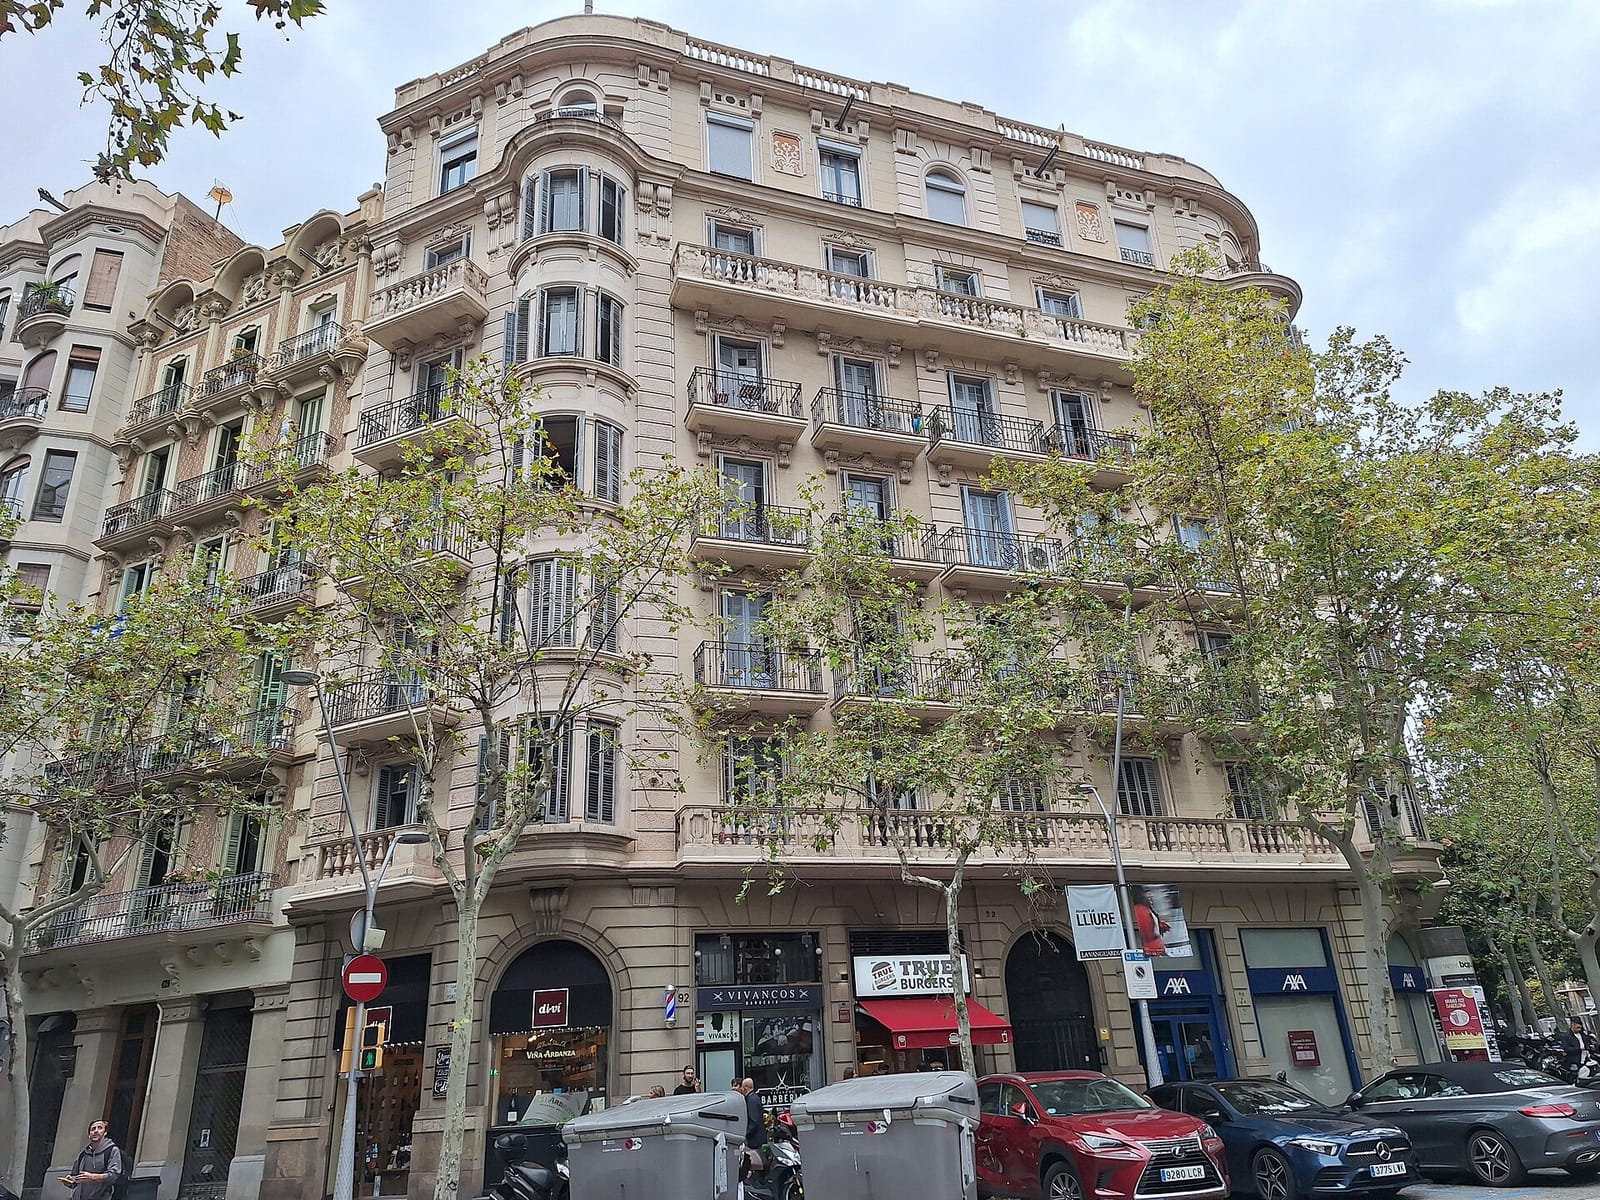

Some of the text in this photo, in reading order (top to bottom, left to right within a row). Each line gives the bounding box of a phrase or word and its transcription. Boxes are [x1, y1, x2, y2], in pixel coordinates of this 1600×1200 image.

[1076, 912, 1117, 926] LLIURE
[872, 966, 894, 979] TRUE
[899, 960, 955, 977] TRUE
[901, 977, 955, 990] BURGERS
[1163, 976, 1191, 994] AXA
[1282, 973, 1307, 991] AXA
[1402, 973, 1416, 988] AXA
[678, 993, 690, 1003] 92
[727, 989, 796, 1001] VIVANCOS
[708, 1031, 738, 1040] VIVANCOS
[526, 1050, 576, 1059] VIÑA ARDANZA
[1166, 1167, 1203, 1180] 9280 LCR
[1375, 1165, 1392, 1175] 3775
